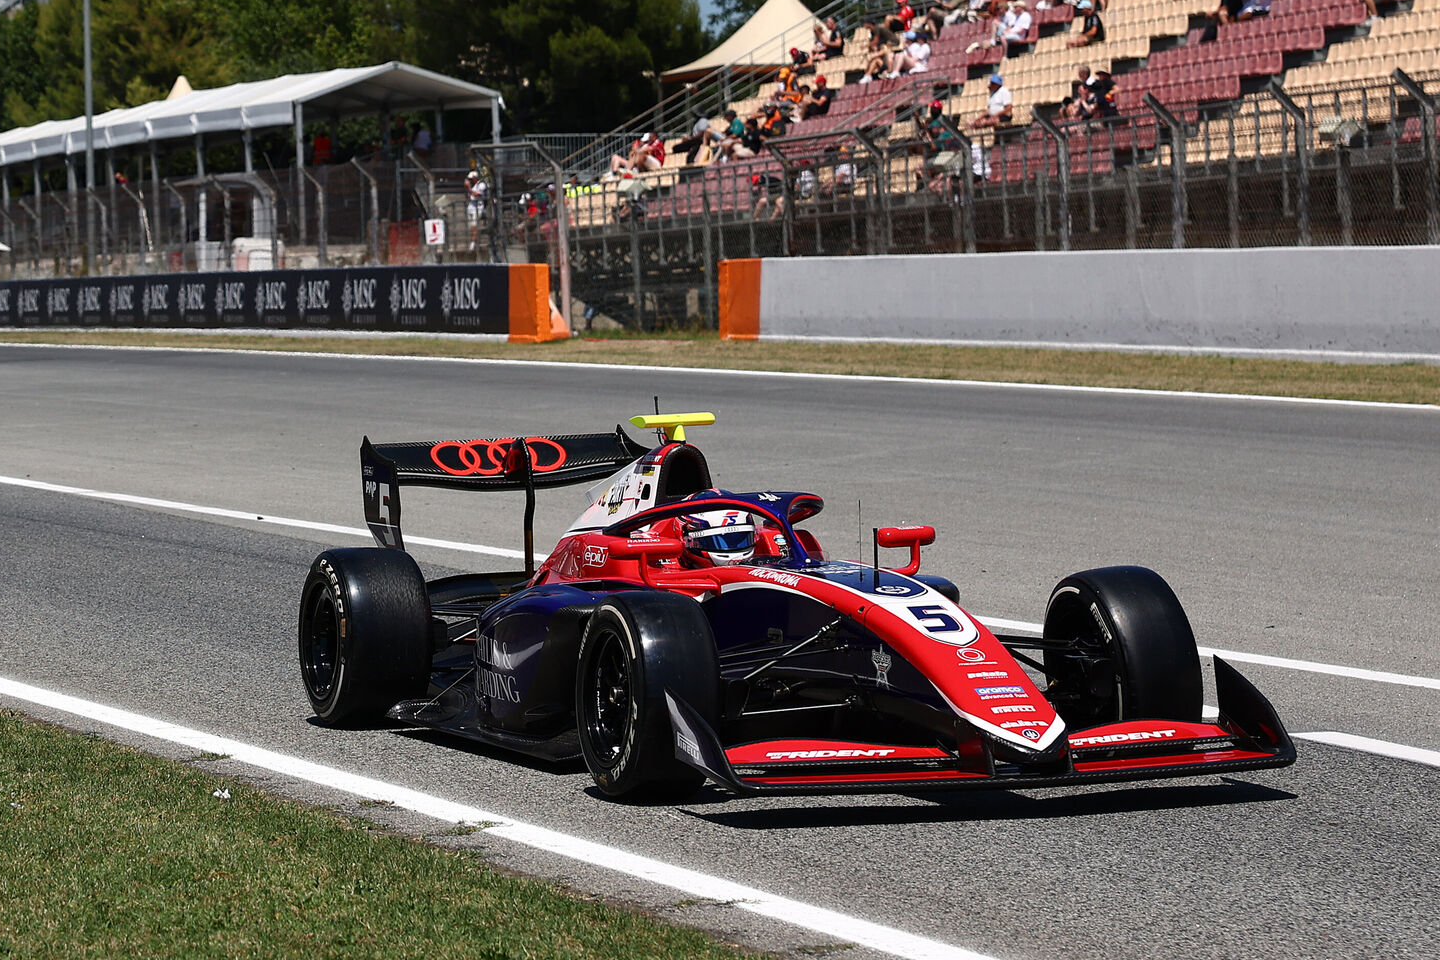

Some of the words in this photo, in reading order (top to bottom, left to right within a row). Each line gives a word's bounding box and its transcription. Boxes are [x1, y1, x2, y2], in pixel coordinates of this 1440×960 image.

[353, 279, 377, 309] MSC
[401, 278, 427, 309] MSC
[453, 278, 480, 309] MSC
[320, 559, 327, 567] P
[907, 605, 964, 633] 5
[502, 642, 514, 670] &
[978, 687, 1022, 695] aramco
[676, 731, 700, 761] PIRELLI
[1068, 729, 1177, 746] TRIDENT
[766, 749, 896, 760] TRIDENT
